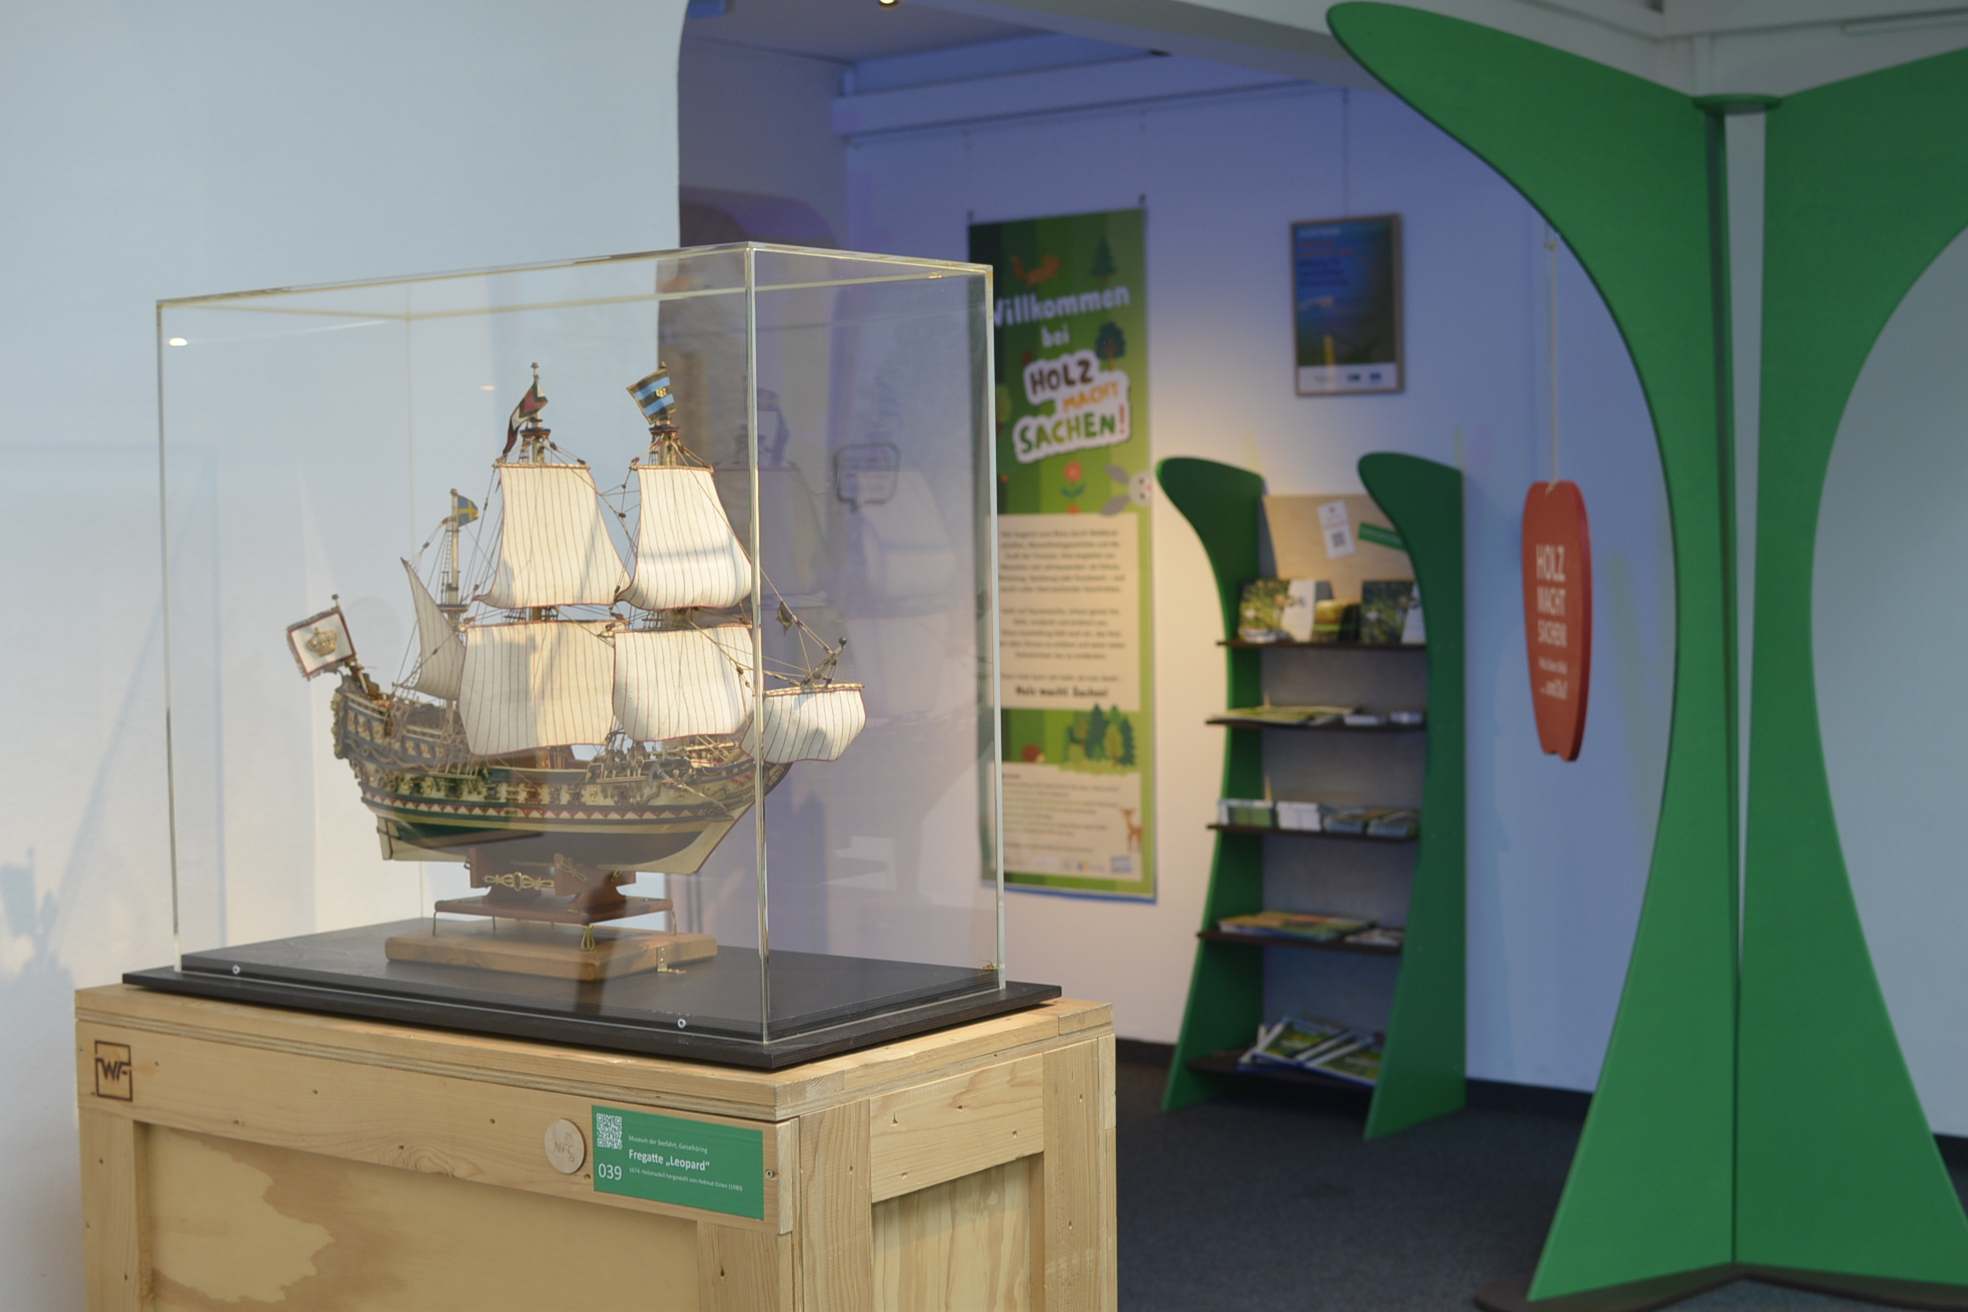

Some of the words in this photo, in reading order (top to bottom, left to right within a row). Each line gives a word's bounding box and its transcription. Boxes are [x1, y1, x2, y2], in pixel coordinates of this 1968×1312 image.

[1041, 323, 1070, 348] bei
[1029, 359, 1093, 395] HOLZ
[1063, 381, 1119, 413] MACHT
[1020, 405, 1126, 453] SACHEN!
[1536, 544, 1566, 582] HOLZ
[1536, 586, 1567, 616] MACHT
[628, 1135, 648, 1144] Museum
[657, 1139, 678, 1149] Seefahrt,
[678, 1142, 708, 1155] Geiselhöring
[628, 1149, 664, 1164] Fregatte
[598, 1163, 623, 1181] 039
[665, 1172, 689, 1183] hergestellt
